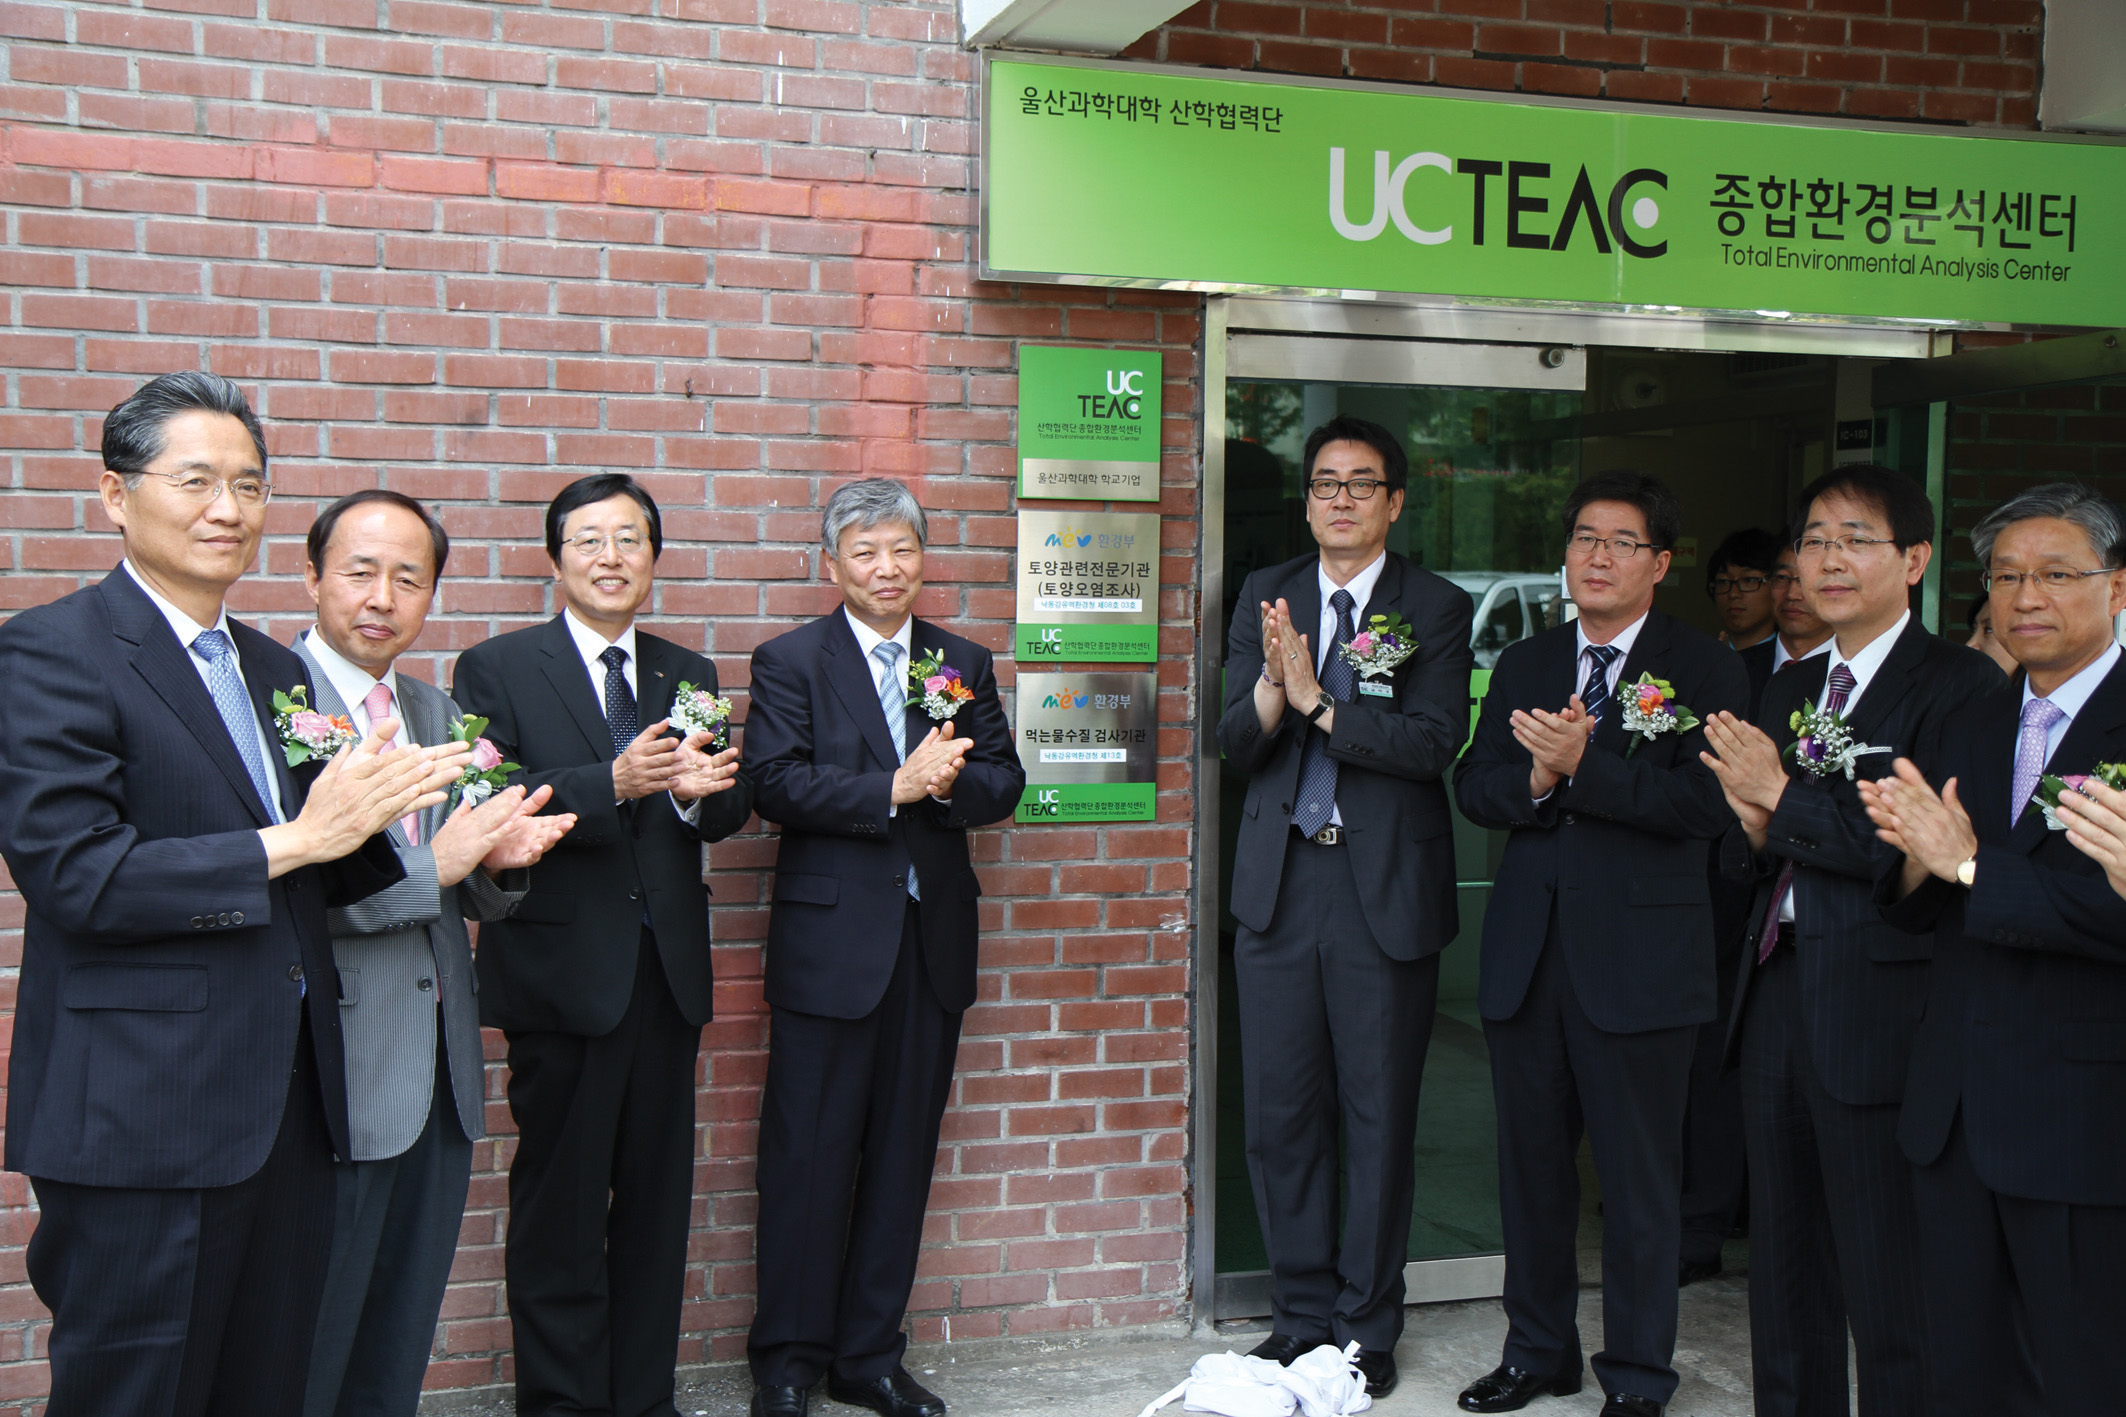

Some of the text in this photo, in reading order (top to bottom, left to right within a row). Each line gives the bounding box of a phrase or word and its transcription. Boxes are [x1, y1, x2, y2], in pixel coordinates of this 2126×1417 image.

[1019, 86, 1284, 133] 울산과학대학 산학협력단
[1710, 173, 2076, 252] 종합환경분석센터
[1721, 243, 2071, 282] Total Environmental Analysis Center
[1106, 370, 1143, 395] UC
[1078, 395, 1141, 420] TEAC
[1037, 422, 1141, 435] 산학협력단 종합환경분석센터
[1055, 433, 1094, 441] Environmental
[1038, 472, 1140, 486] 울산과학대학 학교기업
[1098, 534, 1135, 549] 환경부
[1028, 561, 1150, 578] 토양관련전문기관
[1038, 582, 1141, 599] (토양오염조사)
[1042, 628, 1062, 642] UC
[1026, 642, 1062, 655] TEAC
[1094, 694, 1131, 710] 환경부
[1025, 729, 1146, 743] 먹는물수질 검사기관
[1039, 789, 1059, 803] UC
[1024, 803, 1059, 816] TEAC
